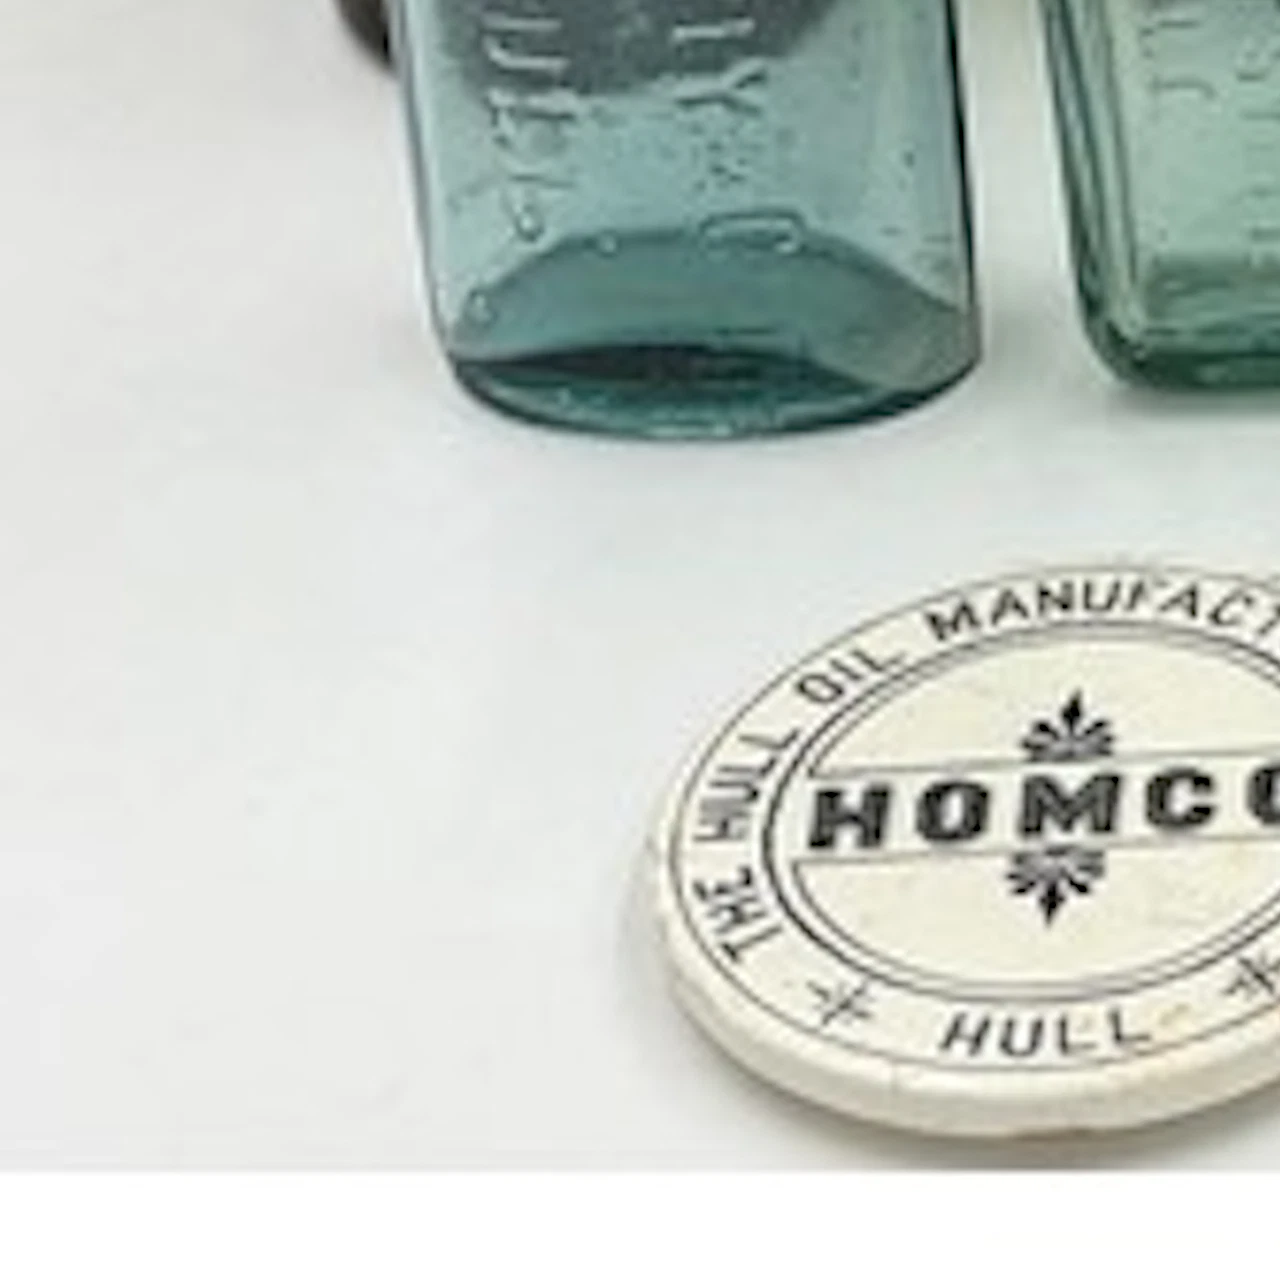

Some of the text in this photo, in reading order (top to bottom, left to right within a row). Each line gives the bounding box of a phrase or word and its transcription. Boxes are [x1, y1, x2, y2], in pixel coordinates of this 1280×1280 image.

[795, 646, 908, 707] OIL
[693, 725, 800, 844] HULL
[695, 867, 781, 964] THE
[938, 1006, 1156, 1056] HULL
